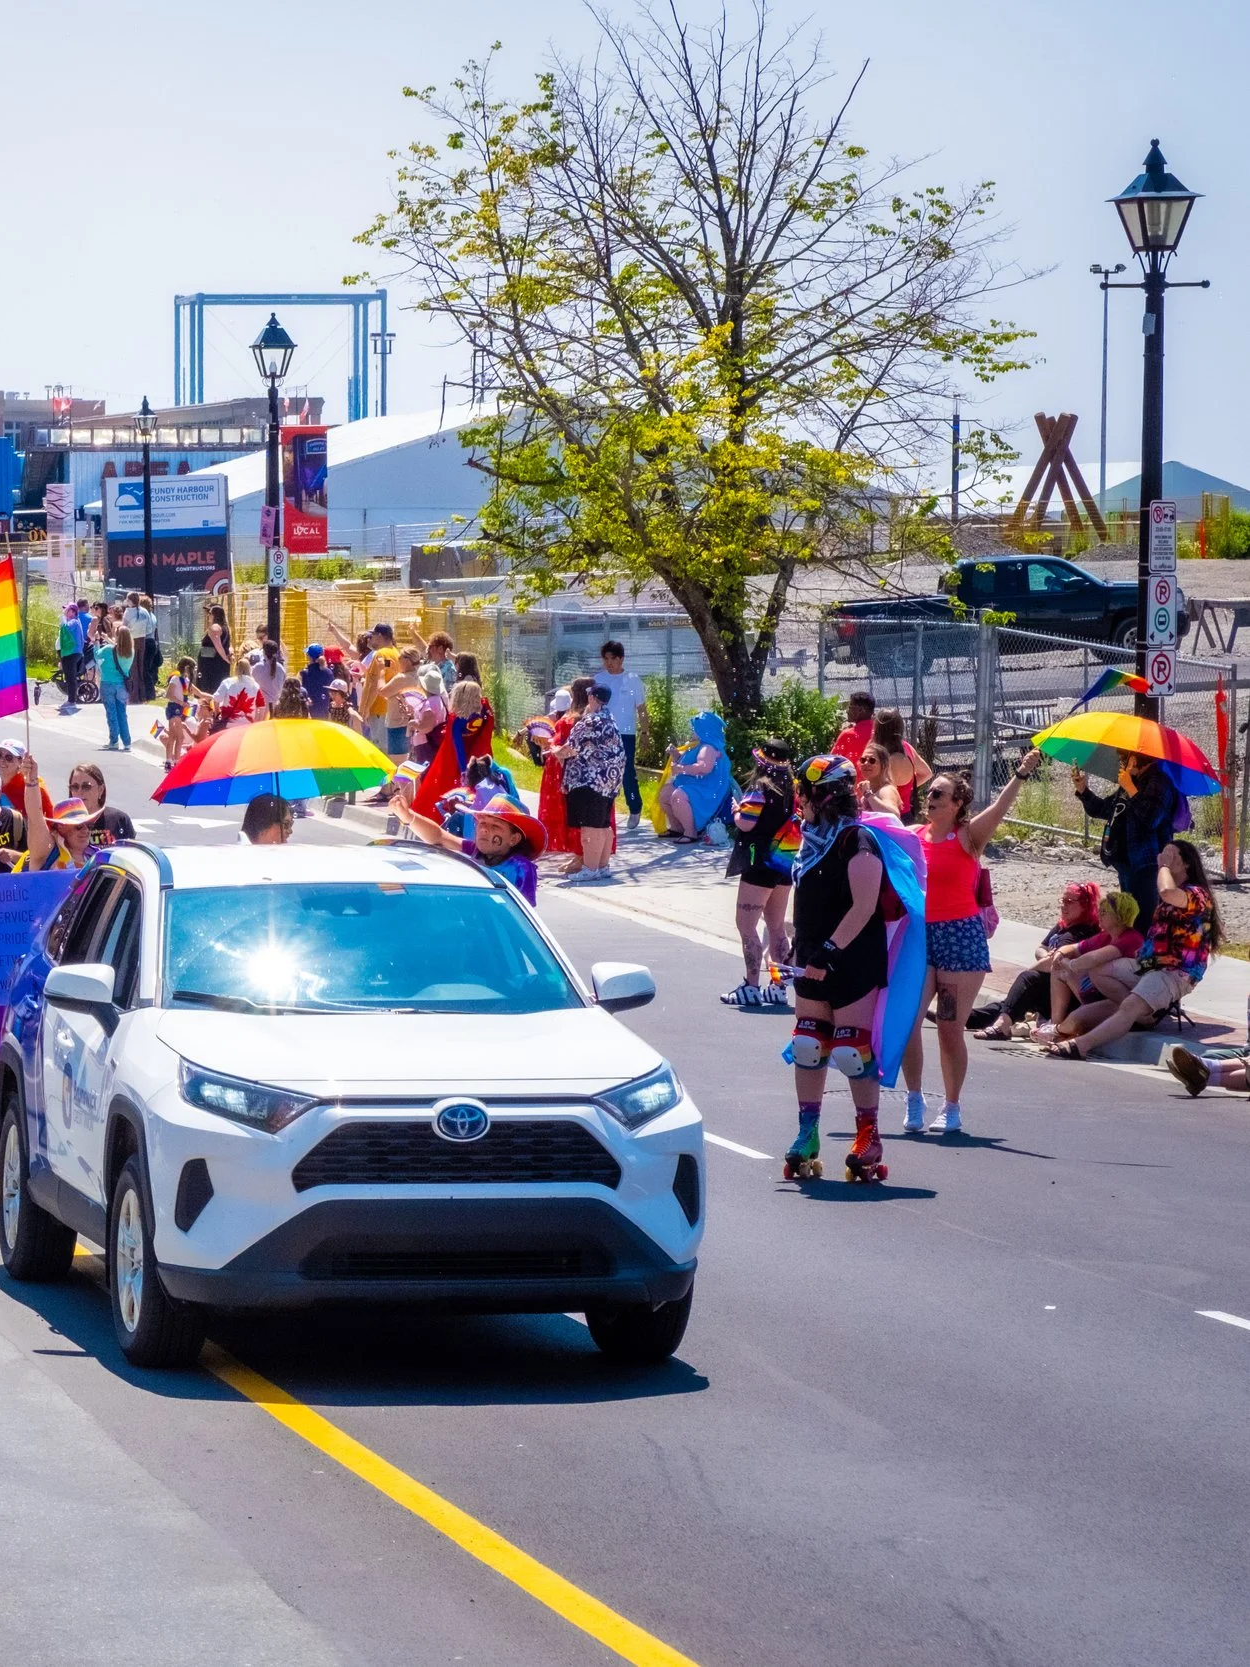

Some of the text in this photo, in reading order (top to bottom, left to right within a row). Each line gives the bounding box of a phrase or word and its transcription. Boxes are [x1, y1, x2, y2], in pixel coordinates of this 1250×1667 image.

[150, 485, 215, 495] FUNDY HARBOUR
[150, 493, 209, 503] CONSTRUCTION
[293, 526, 321, 535] LOCAL
[117, 550, 216, 568] IRON MAPLE
